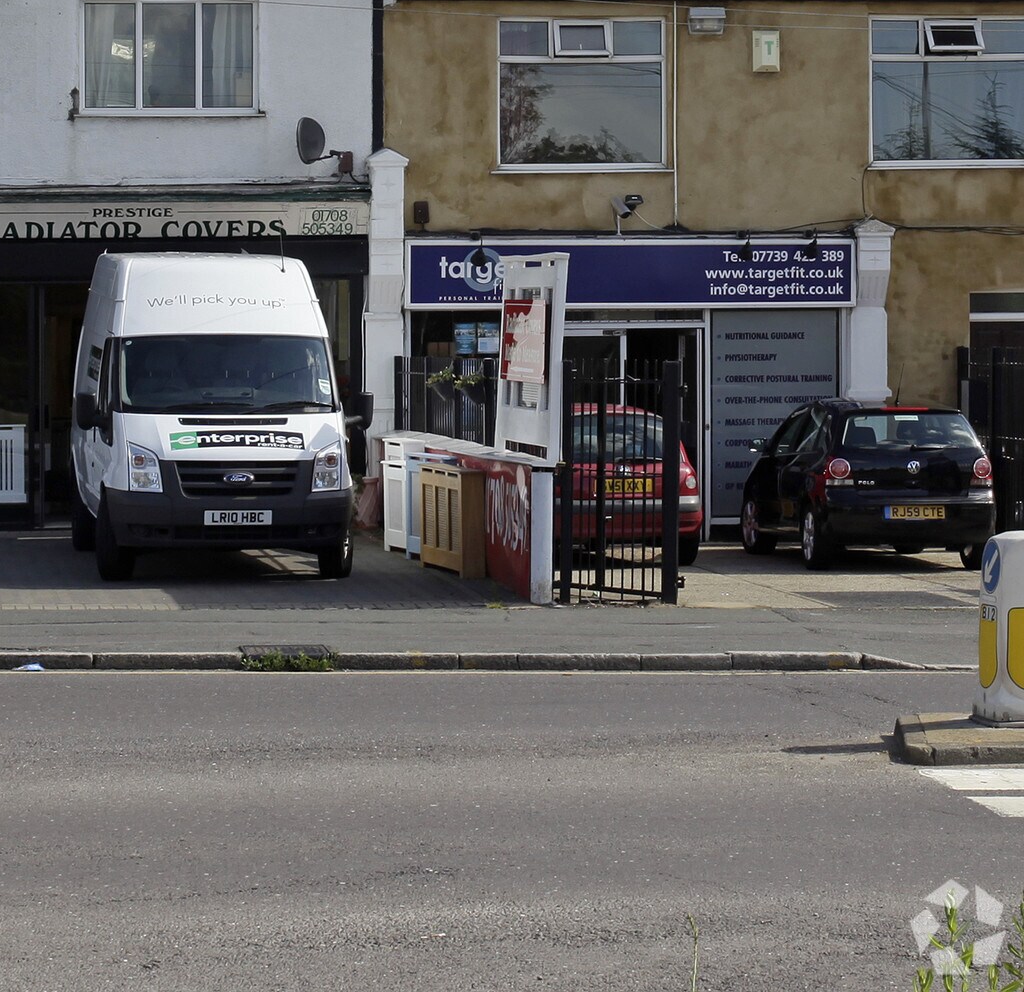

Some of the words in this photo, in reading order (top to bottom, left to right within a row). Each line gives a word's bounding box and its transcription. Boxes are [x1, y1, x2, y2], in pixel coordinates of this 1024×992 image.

[92, 208, 174, 218] PRESTIGE
[311, 209, 348, 222] 01708
[160, 219, 287, 239] COVERS
[301, 222, 353, 235] 505349
[752, 250, 788, 262] 07739
[821, 250, 844, 262] 389
[439, 256, 506, 284] targe
[705, 266, 844, 281] www.targetfit.co.uk
[493, 277, 502, 295] fi
[710, 283, 844, 298] info@targetfit.co.uk
[147, 295, 187, 308] We'll
[192, 294, 224, 306] pick
[228, 297, 257, 306] you
[724, 332, 769, 340] NUTRITIONAL
[770, 332, 805, 340] GUIDANCE
[724, 353, 778, 362] PHYSIOTHERAPY
[724, 375, 764, 383] CORRECTIVE
[766, 374, 799, 383] POSTURAL
[801, 374, 833, 382] TRAINING
[724, 396, 782, 404] OVER-THE-PHONE
[724, 418, 755, 426] MASSAGE
[172, 433, 303, 445] enterprise
[724, 461, 752, 469] MARATH
[211, 512, 238, 523] LR10
[241, 512, 265, 523] HBC
[892, 507, 920, 517] RJ59
[922, 507, 944, 517] CTE
